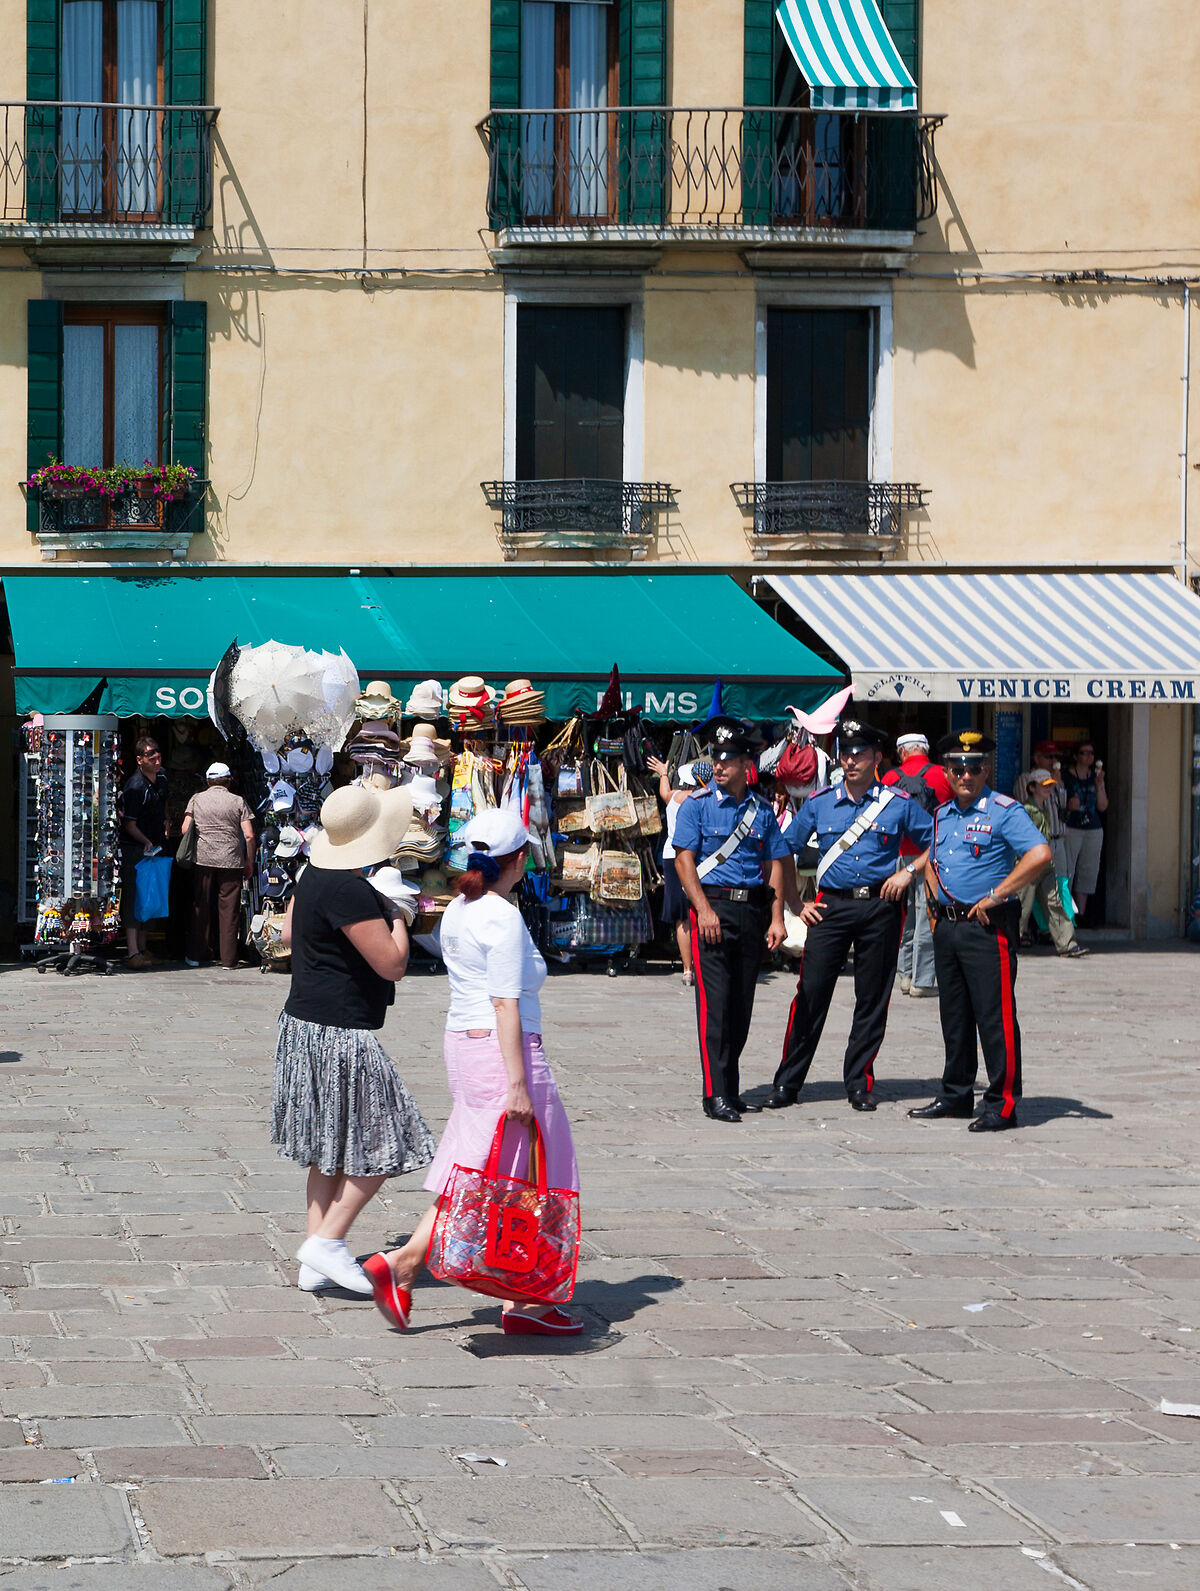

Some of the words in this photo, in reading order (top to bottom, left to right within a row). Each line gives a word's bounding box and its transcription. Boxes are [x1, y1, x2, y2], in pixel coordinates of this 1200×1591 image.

[867, 674, 932, 698] GELATERIA
[956, 679, 1071, 698] VENICE
[1086, 679, 1196, 699] CREAM
[596, 691, 698, 714] LMS
